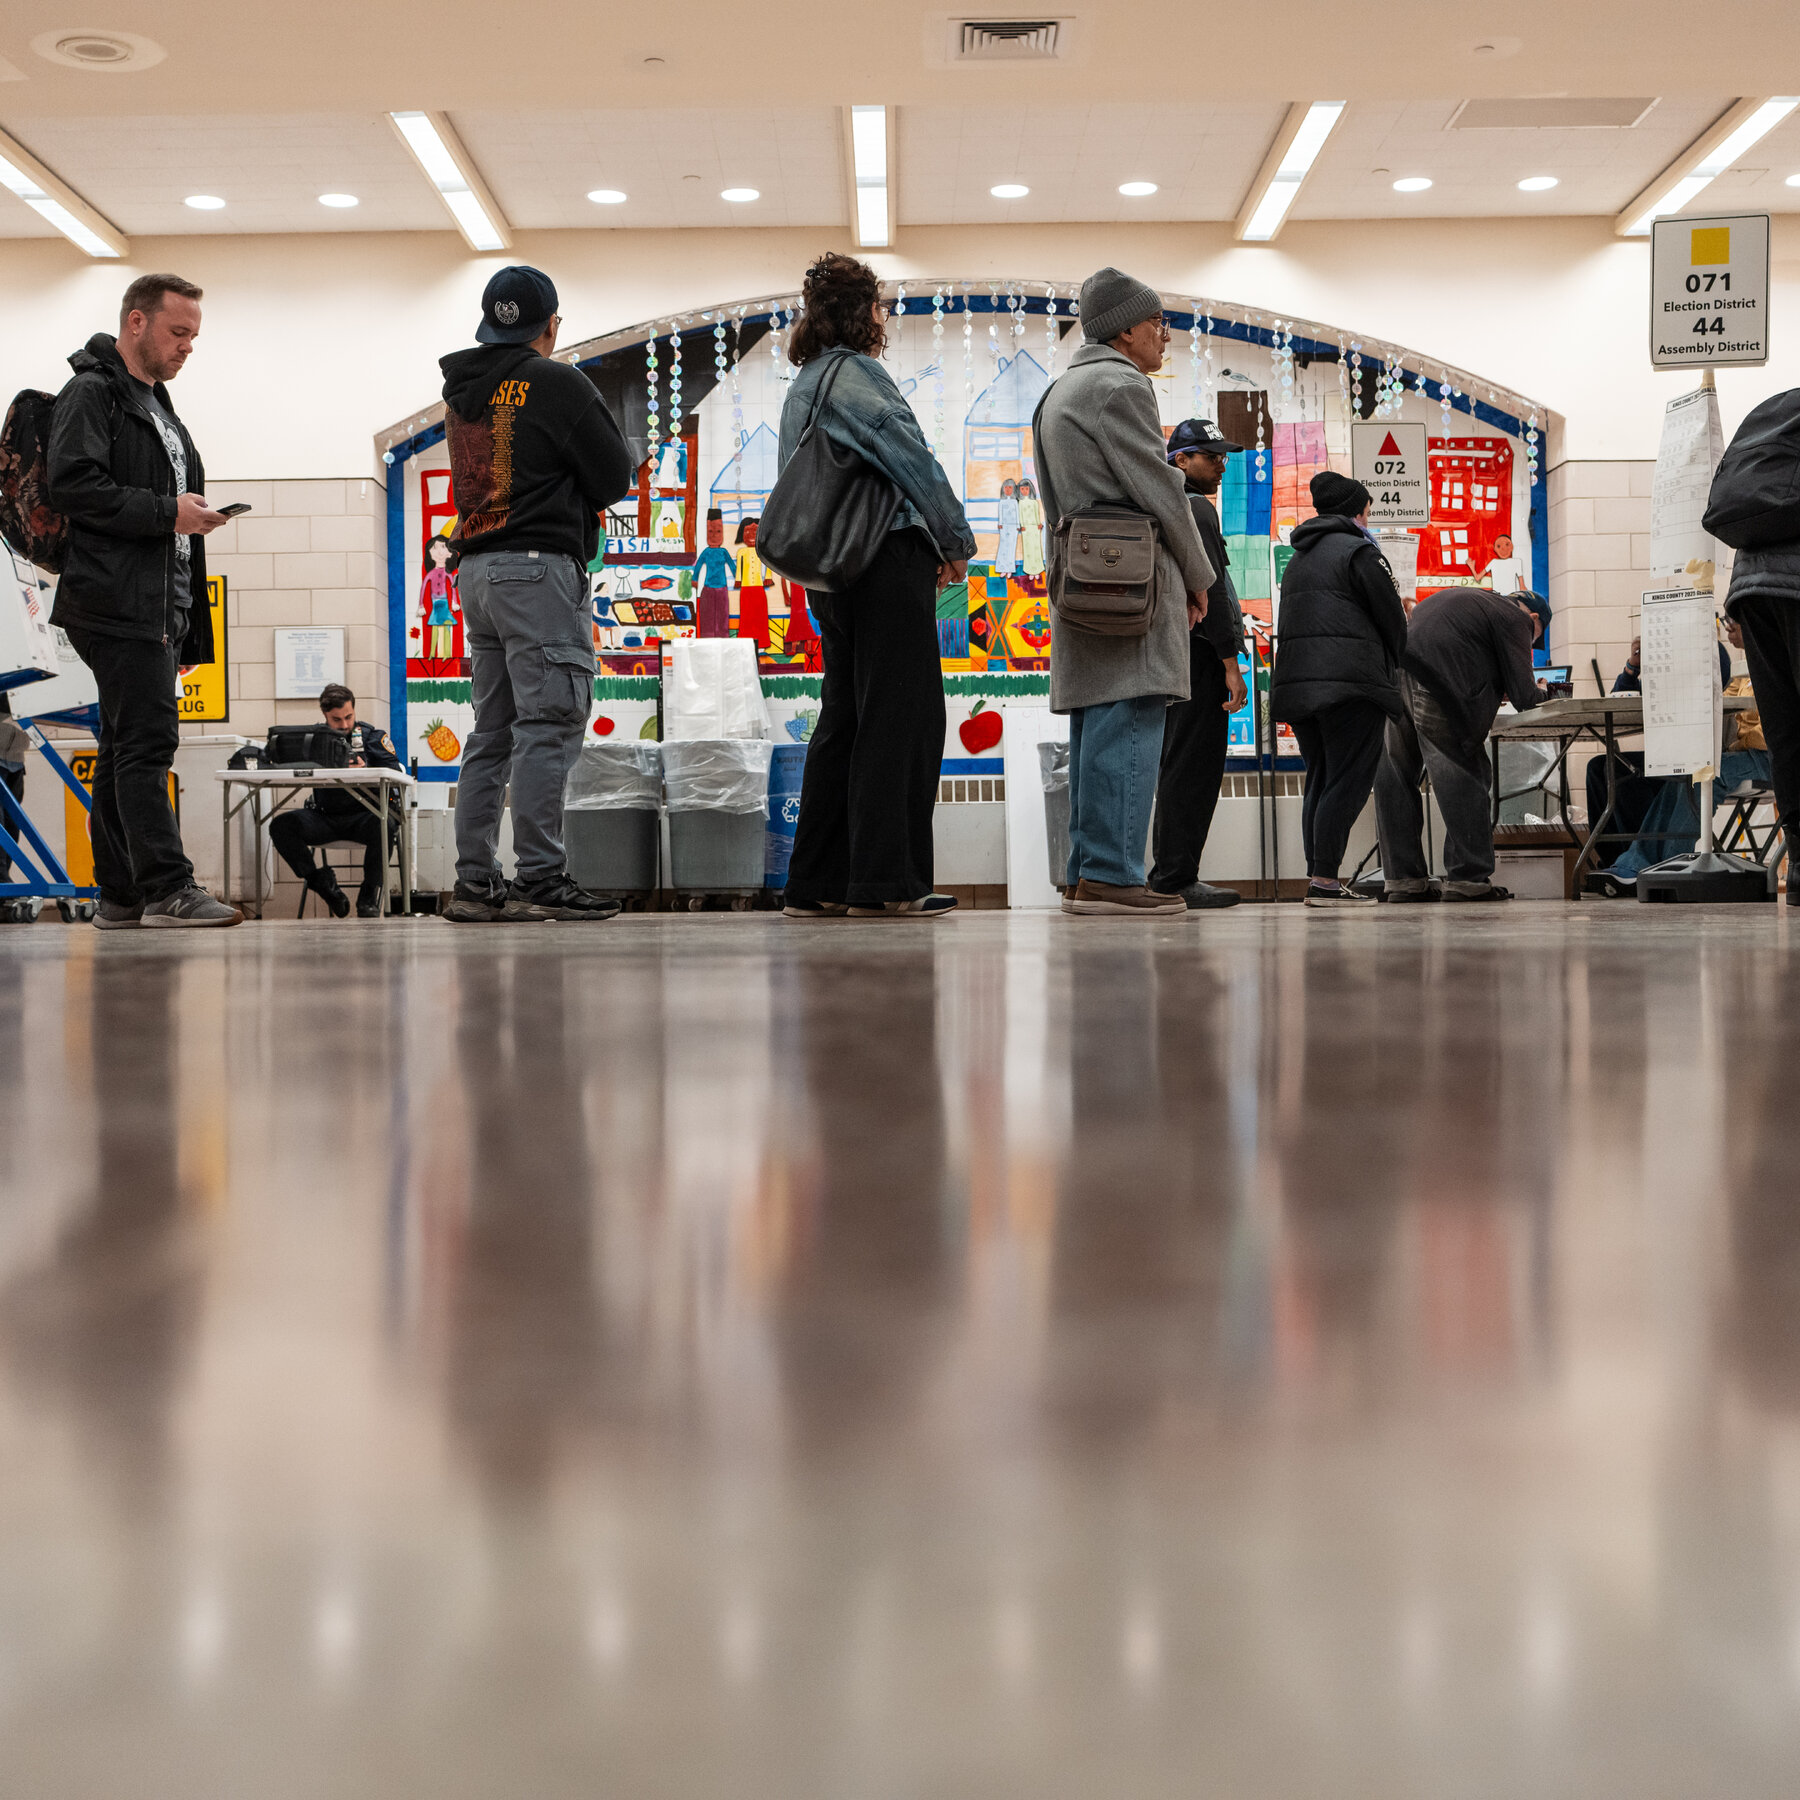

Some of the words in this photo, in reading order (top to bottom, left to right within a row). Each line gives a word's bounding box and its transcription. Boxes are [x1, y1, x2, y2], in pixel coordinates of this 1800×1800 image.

[1685, 272, 1731, 293] 071
[1663, 301, 1711, 312] Election
[1713, 298, 1756, 309] District
[1692, 317, 1725, 336] 44
[1658, 342, 1715, 355] Assembly
[1717, 340, 1761, 352] District
[1374, 461, 1406, 475] 072
[1393, 479, 1421, 487] District
[1380, 492, 1402, 504] 44
[1396, 507, 1425, 516] District
[605, 536, 649, 554] FISH
